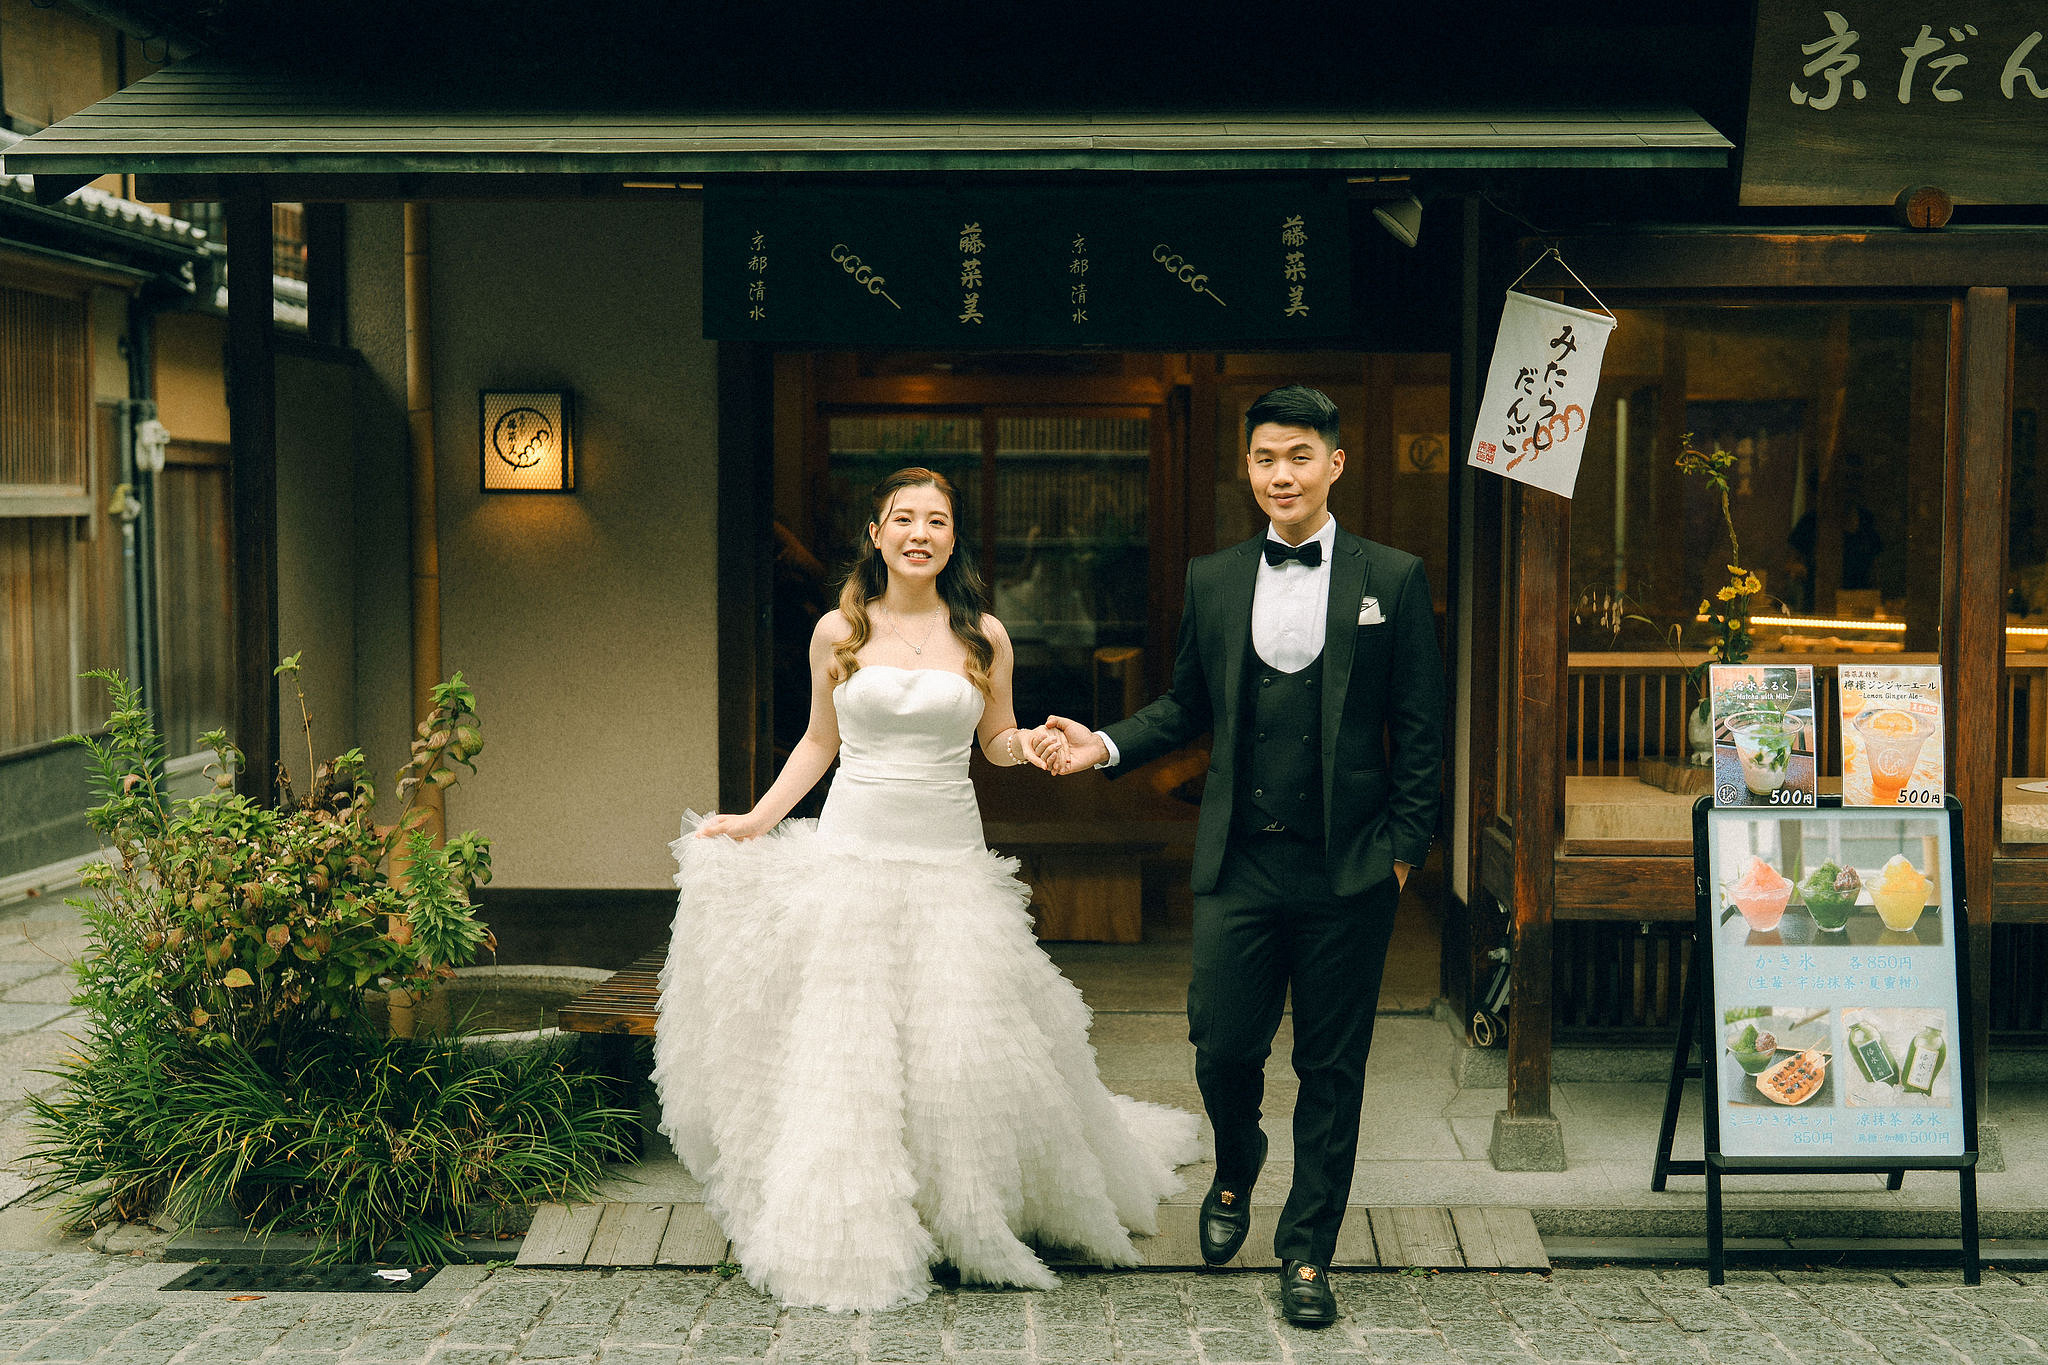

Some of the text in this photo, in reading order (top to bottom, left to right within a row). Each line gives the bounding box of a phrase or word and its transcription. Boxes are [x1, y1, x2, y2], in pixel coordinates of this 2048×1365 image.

[1790, 10, 2048, 110] 京だん
[747, 229, 768, 322] 京都清水
[958, 221, 986, 325] 藤菜美
[1069, 231, 1090, 325] 京都清水
[1281, 215, 1311, 318] 藤菜美
[1502, 366, 1539, 454] だんご
[1532, 325, 1577, 451] みたらし
[1885, 692, 1906, 700] Ginger
[1769, 789, 1813, 804] 500円
[1897, 789, 1940, 804] 500円
[1755, 952, 1912, 971] かき氷 各850円
[1793, 1131, 1833, 1145] 850円
[1910, 1131, 1950, 1144] 500円
